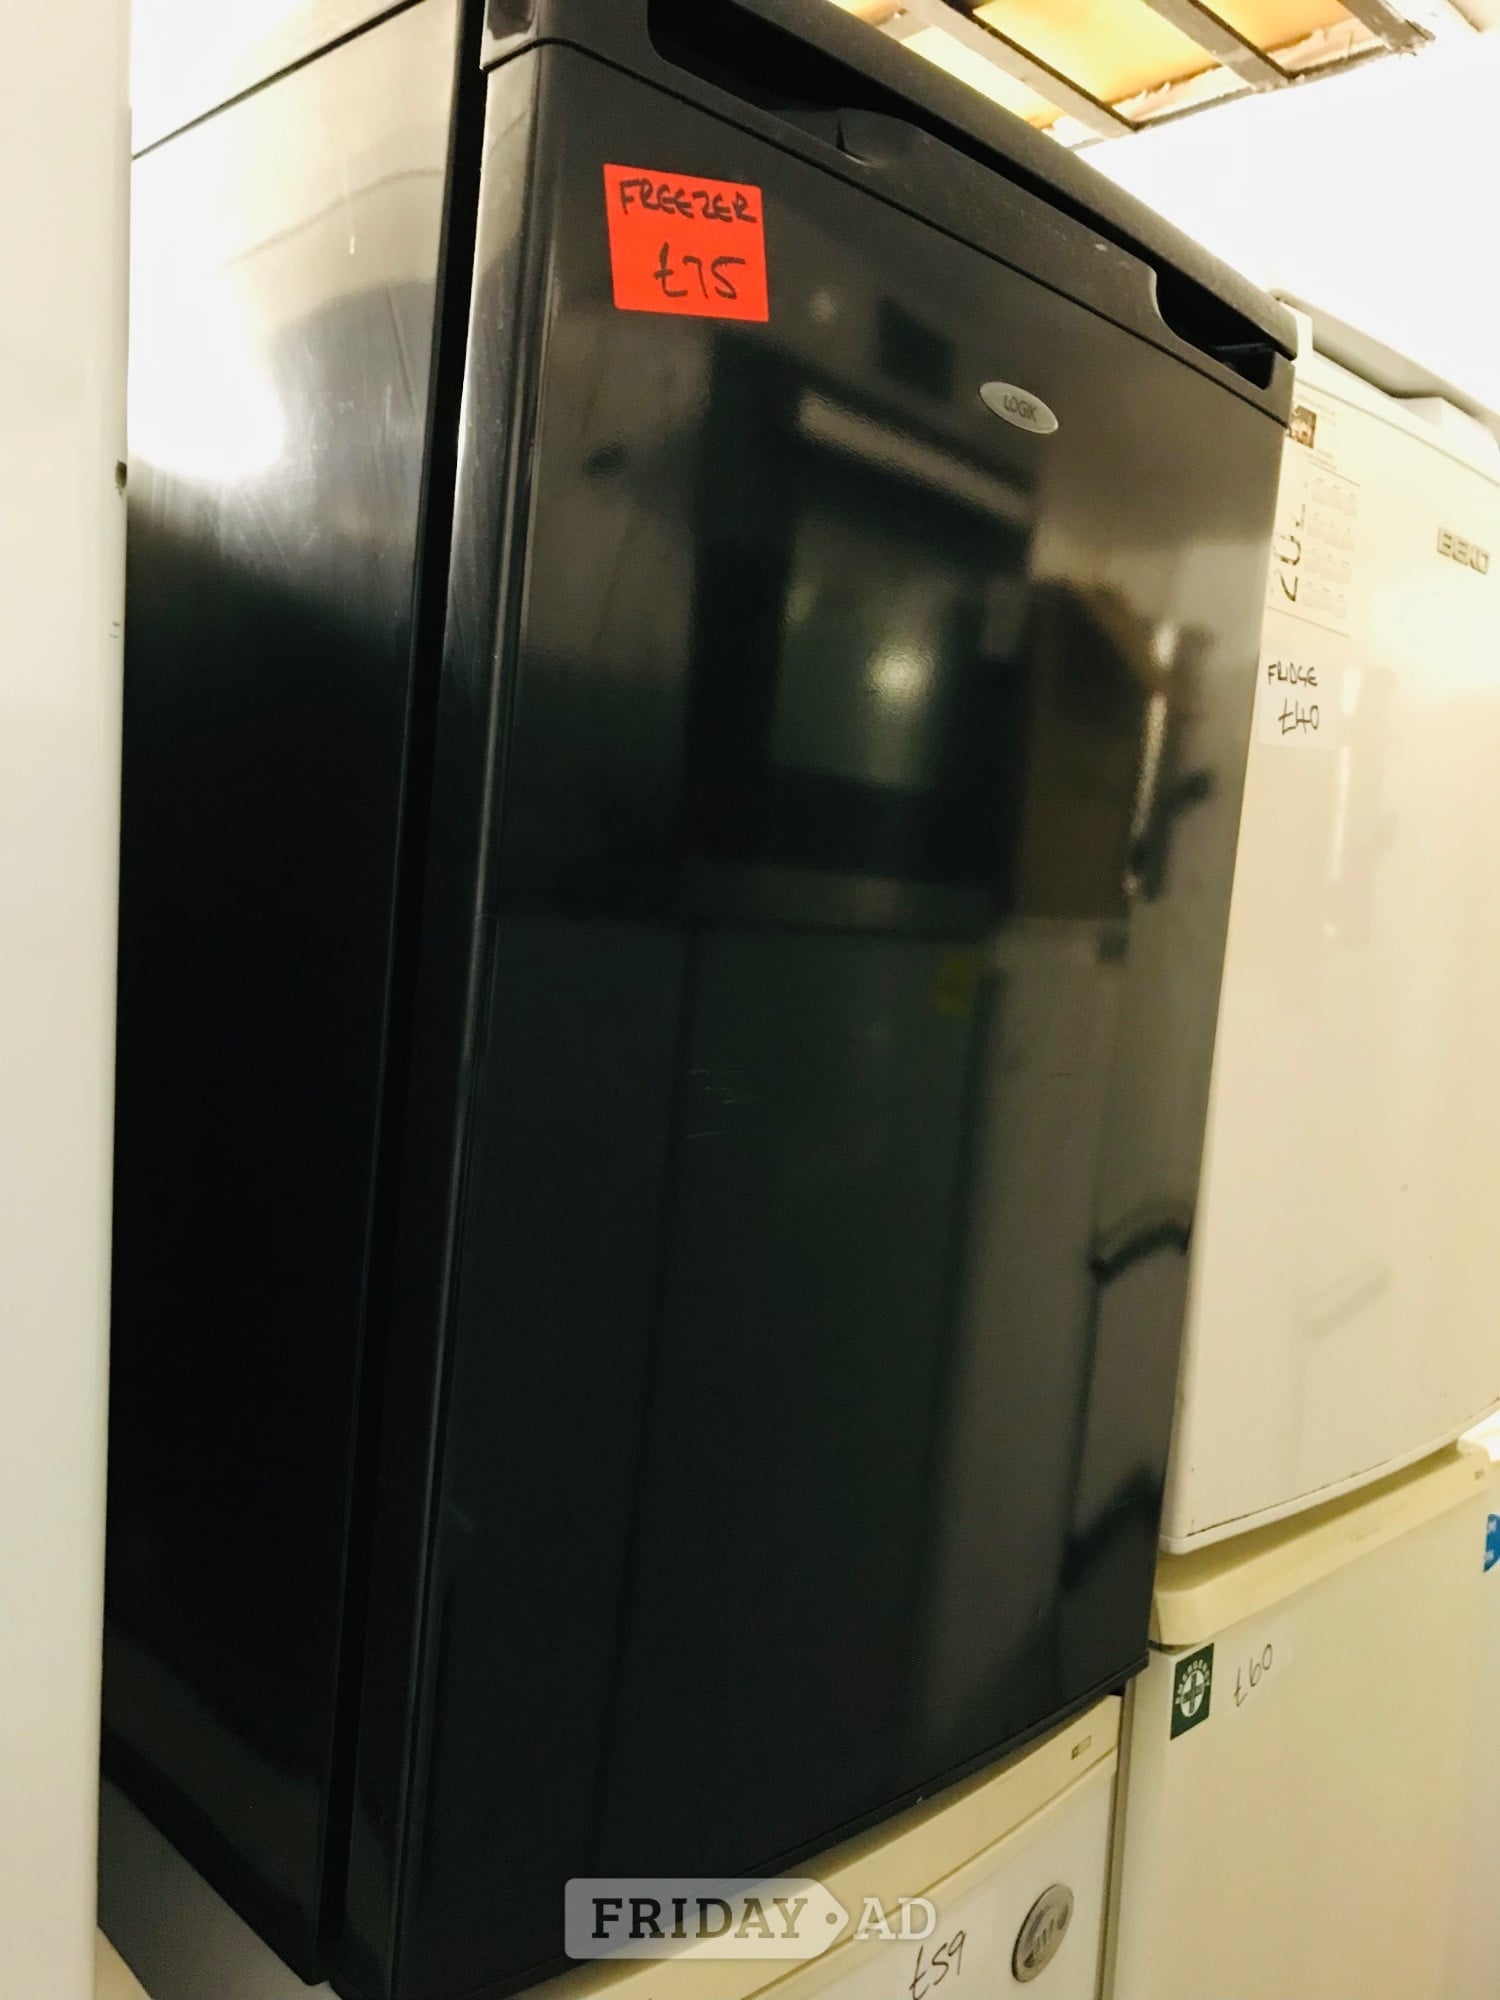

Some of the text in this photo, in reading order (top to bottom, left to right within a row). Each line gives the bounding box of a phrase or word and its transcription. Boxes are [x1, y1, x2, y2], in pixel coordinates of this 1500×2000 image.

[620, 178, 757, 223] FREEZER
[653, 242, 746, 300] £75
[1278, 697, 1320, 735] £40
[1233, 1643, 1273, 1707] £60
[909, 1930, 967, 2000] £59
